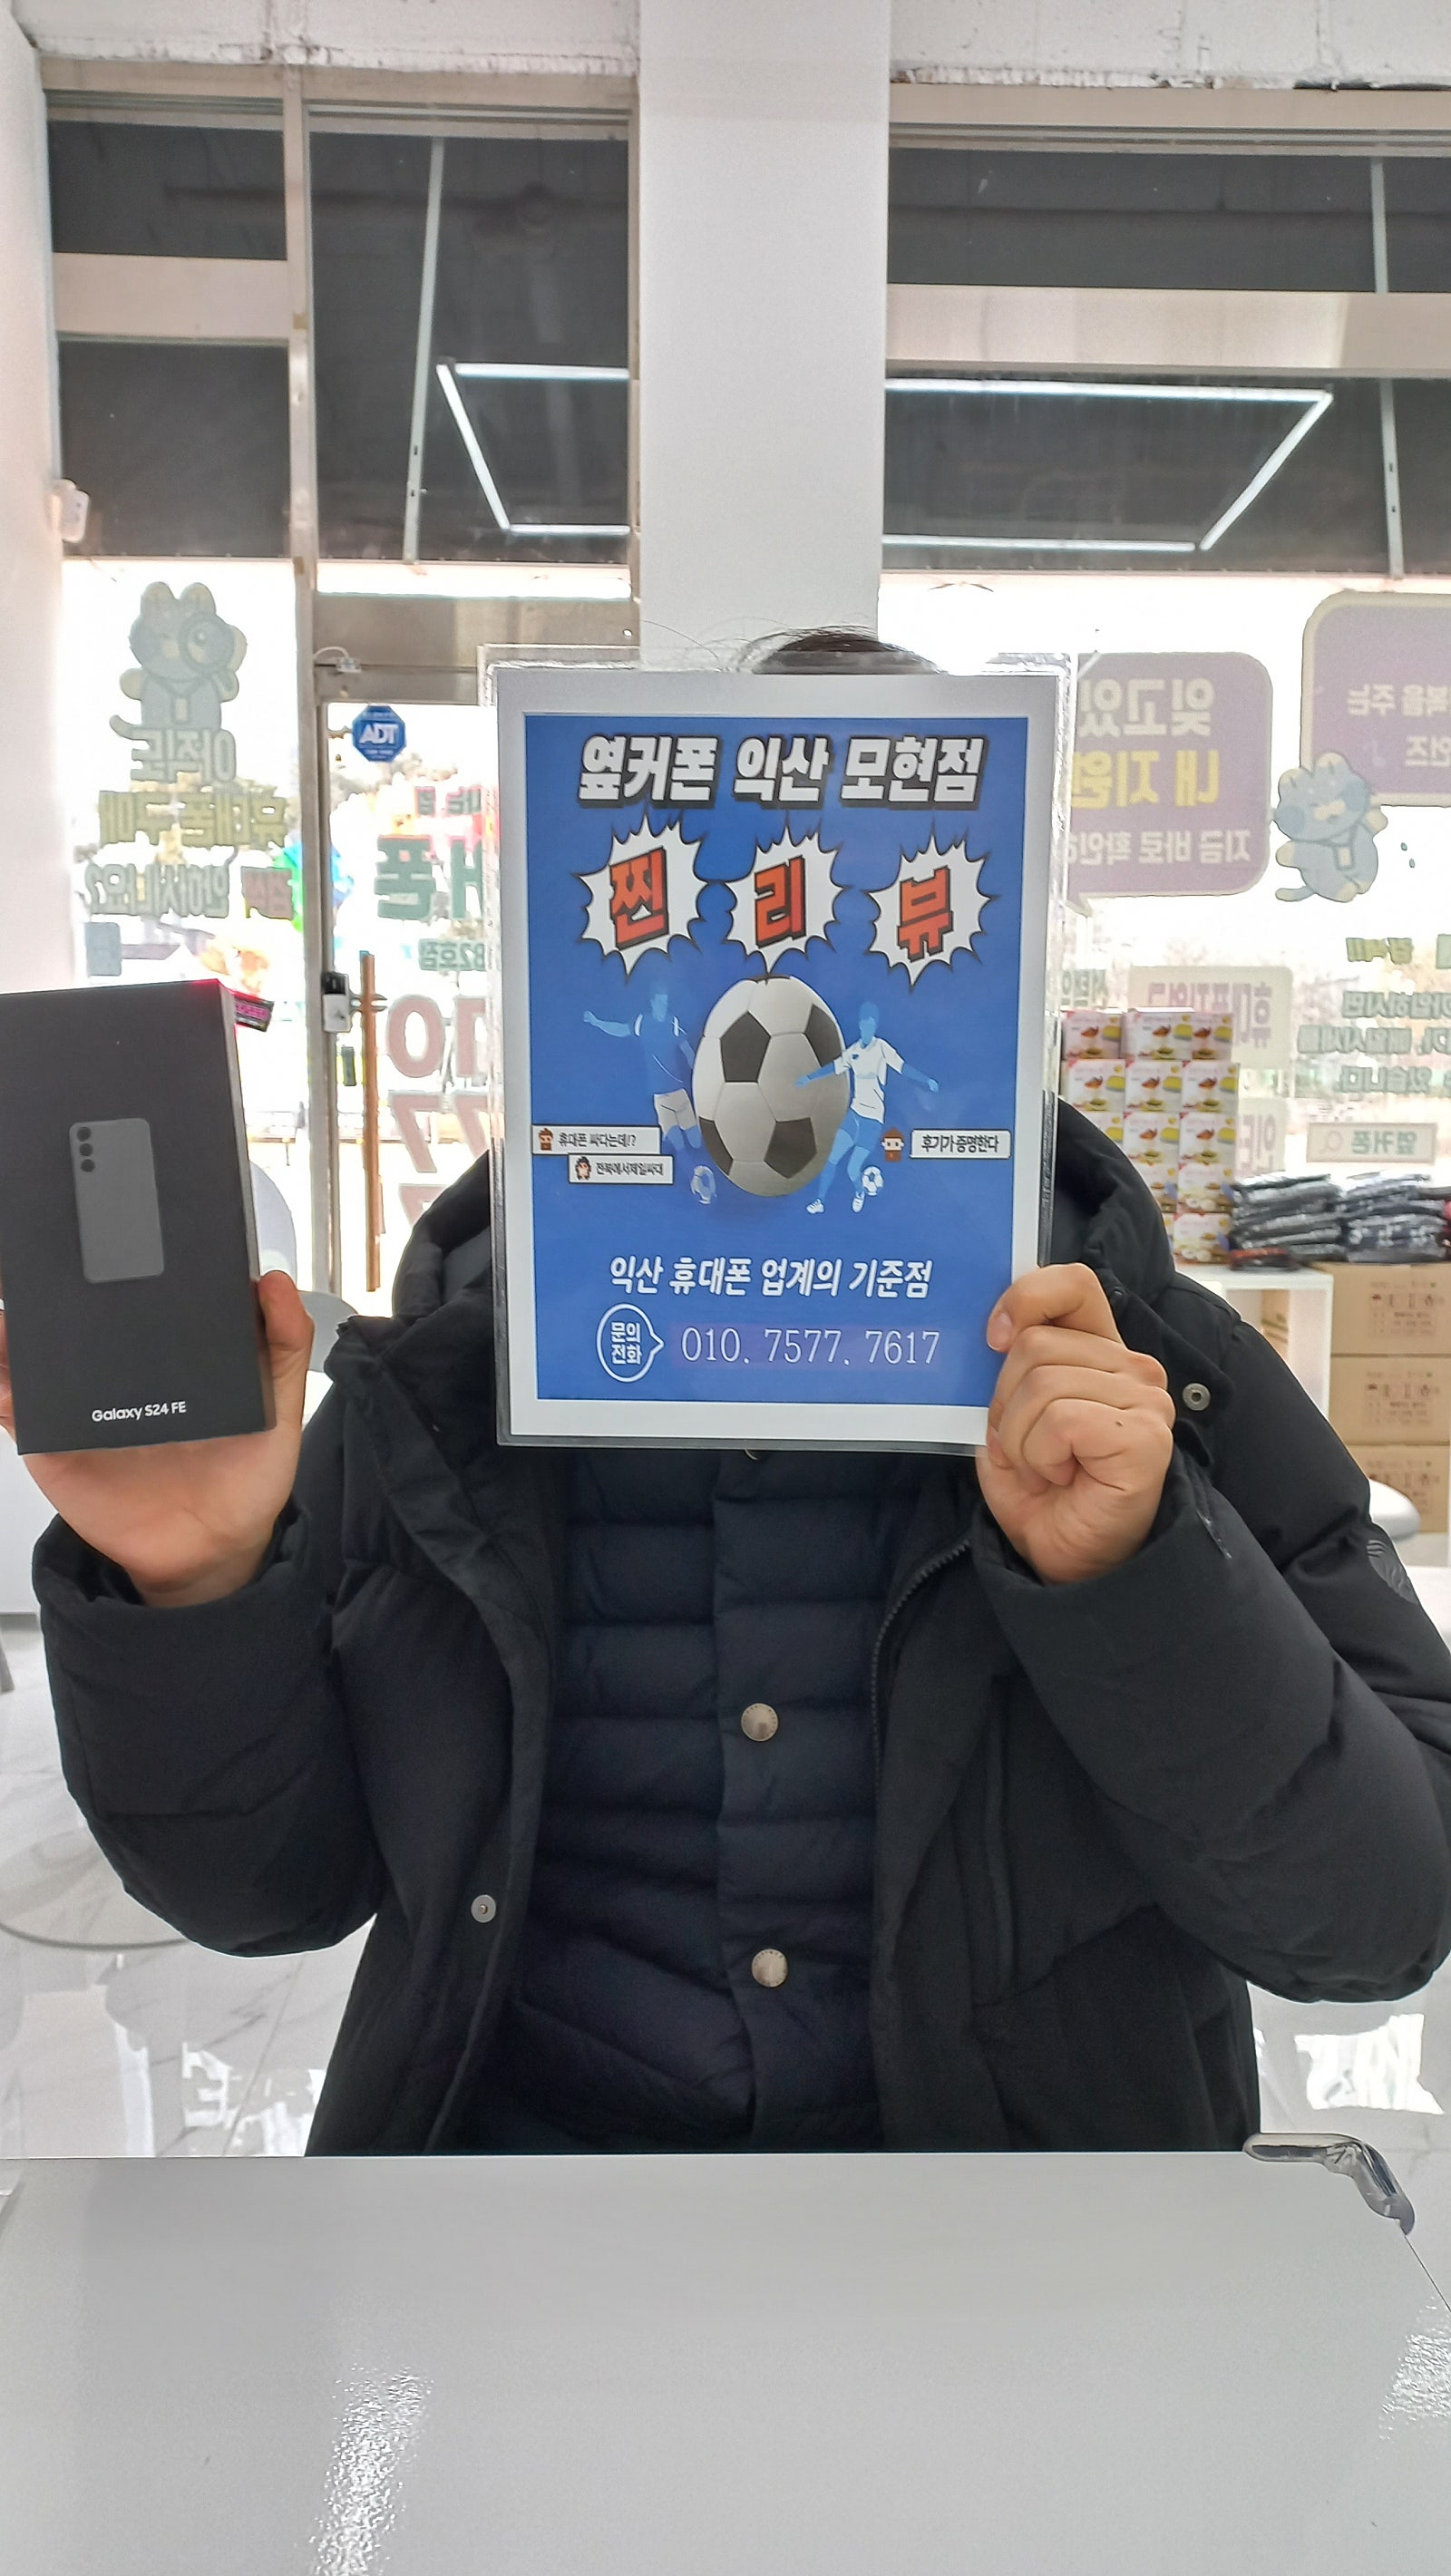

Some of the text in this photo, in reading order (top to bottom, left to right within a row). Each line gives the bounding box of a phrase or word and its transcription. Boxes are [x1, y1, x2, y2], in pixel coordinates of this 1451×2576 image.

[358, 723, 399, 744] ADT
[579, 734, 988, 808] 옆커폰 익산 모현점
[609, 846, 954, 962] 찐 리 뷰
[558, 1132, 588, 1148] 휴대폰
[609, 1255, 934, 1299] 익산 휴대폰 업계의 기준점
[610, 1320, 642, 1343] 문의
[610, 1343, 643, 1366] 전화
[864, 1329, 940, 1366] 7617
[92, 1401, 187, 1422] Galaxy S24 FE
